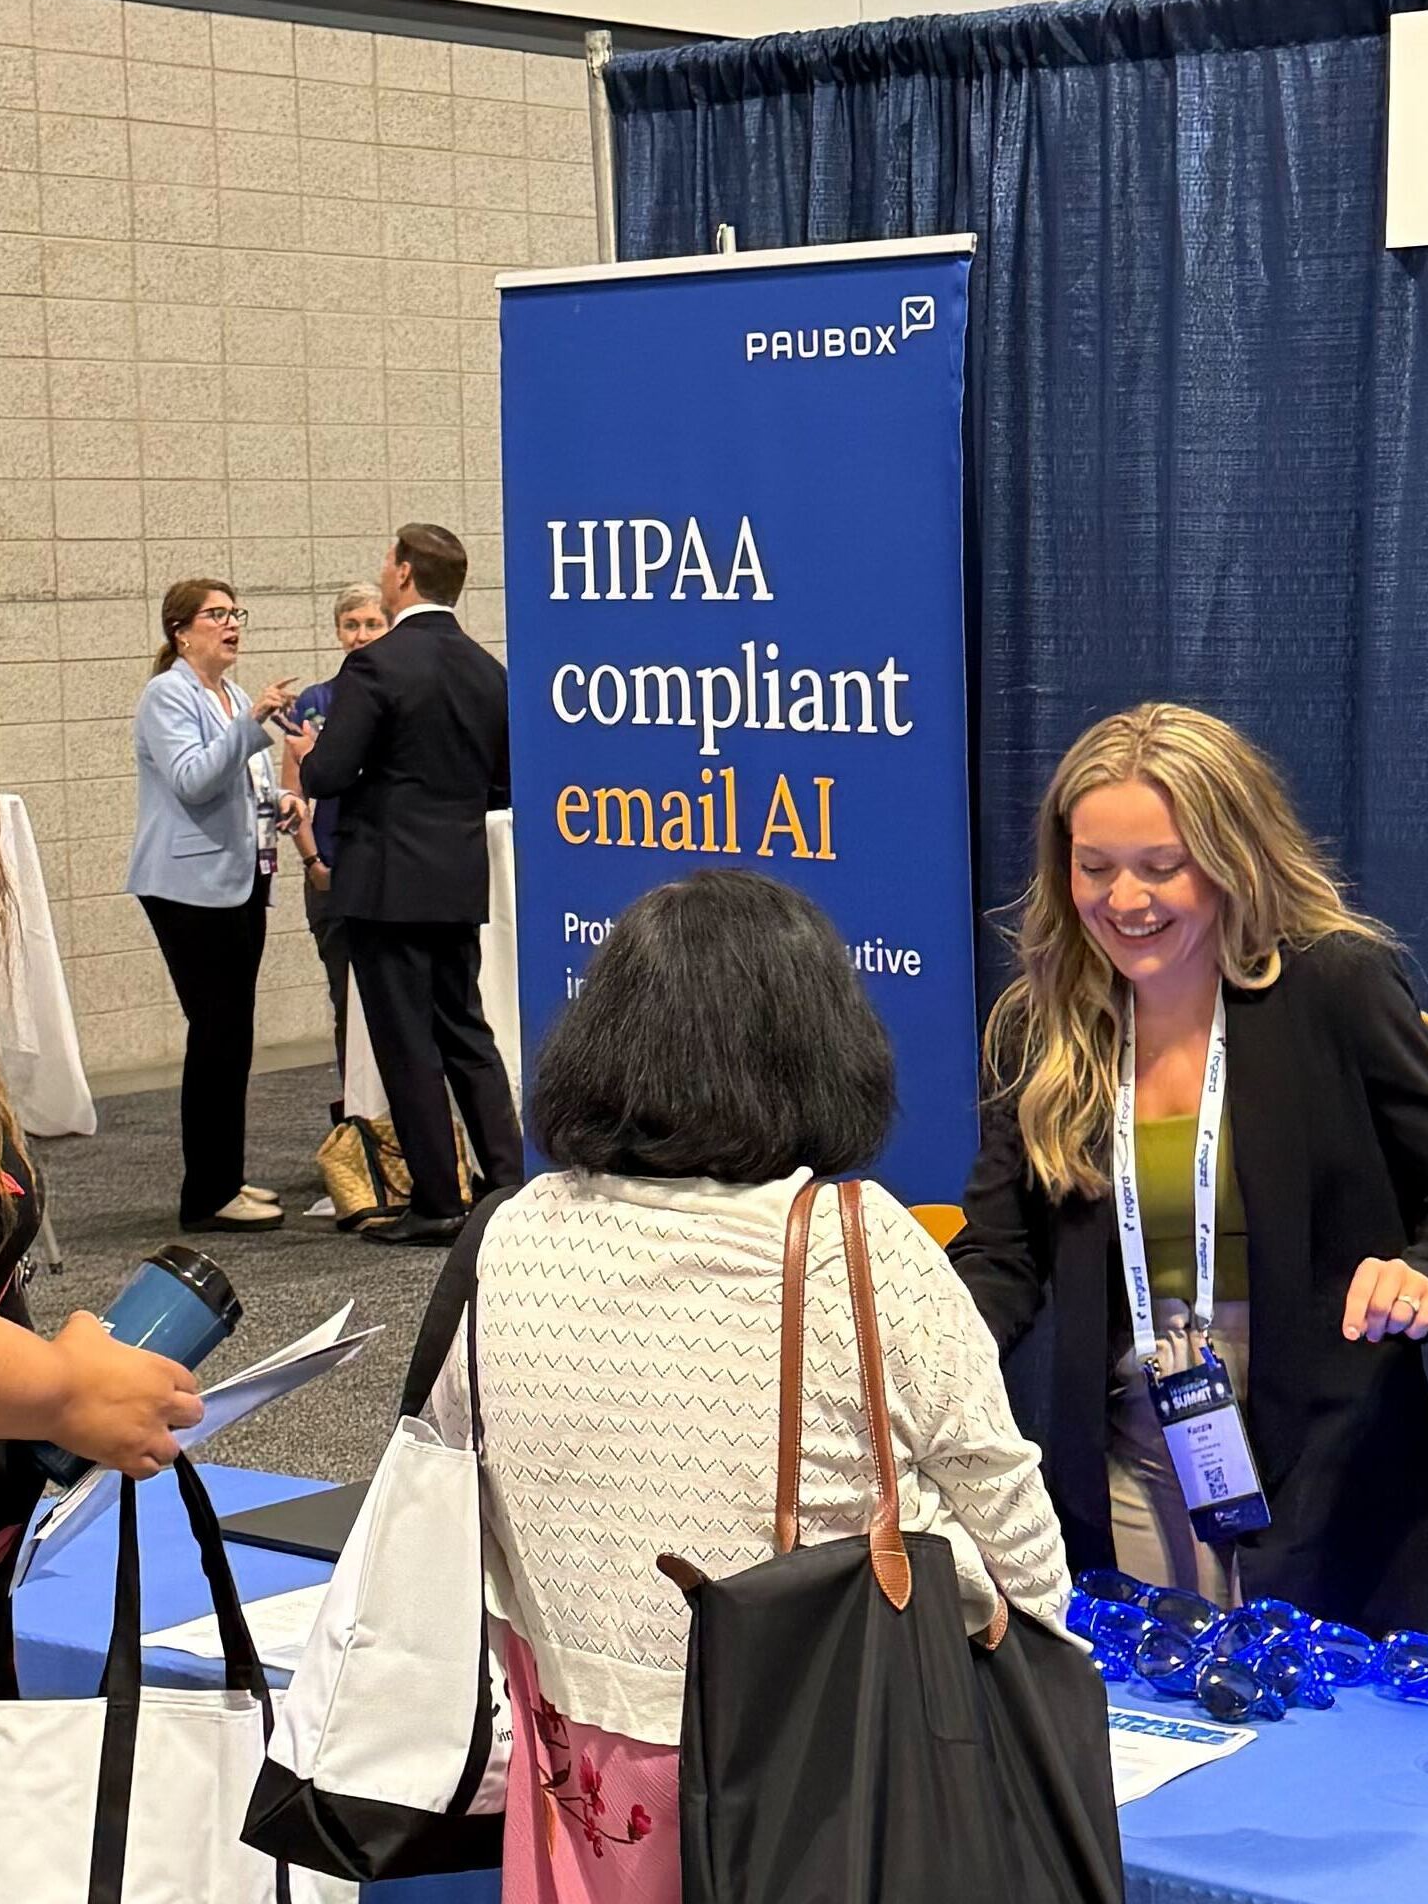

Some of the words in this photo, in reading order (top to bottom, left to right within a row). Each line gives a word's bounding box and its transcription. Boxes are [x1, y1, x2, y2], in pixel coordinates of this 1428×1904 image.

[747, 326, 895, 361] PAUBOX
[547, 516, 773, 600] HIPAA
[553, 641, 912, 755] compliant
[557, 767, 741, 853] email
[757, 774, 836, 860] AI
[1122, 1176, 1135, 1218] regard
